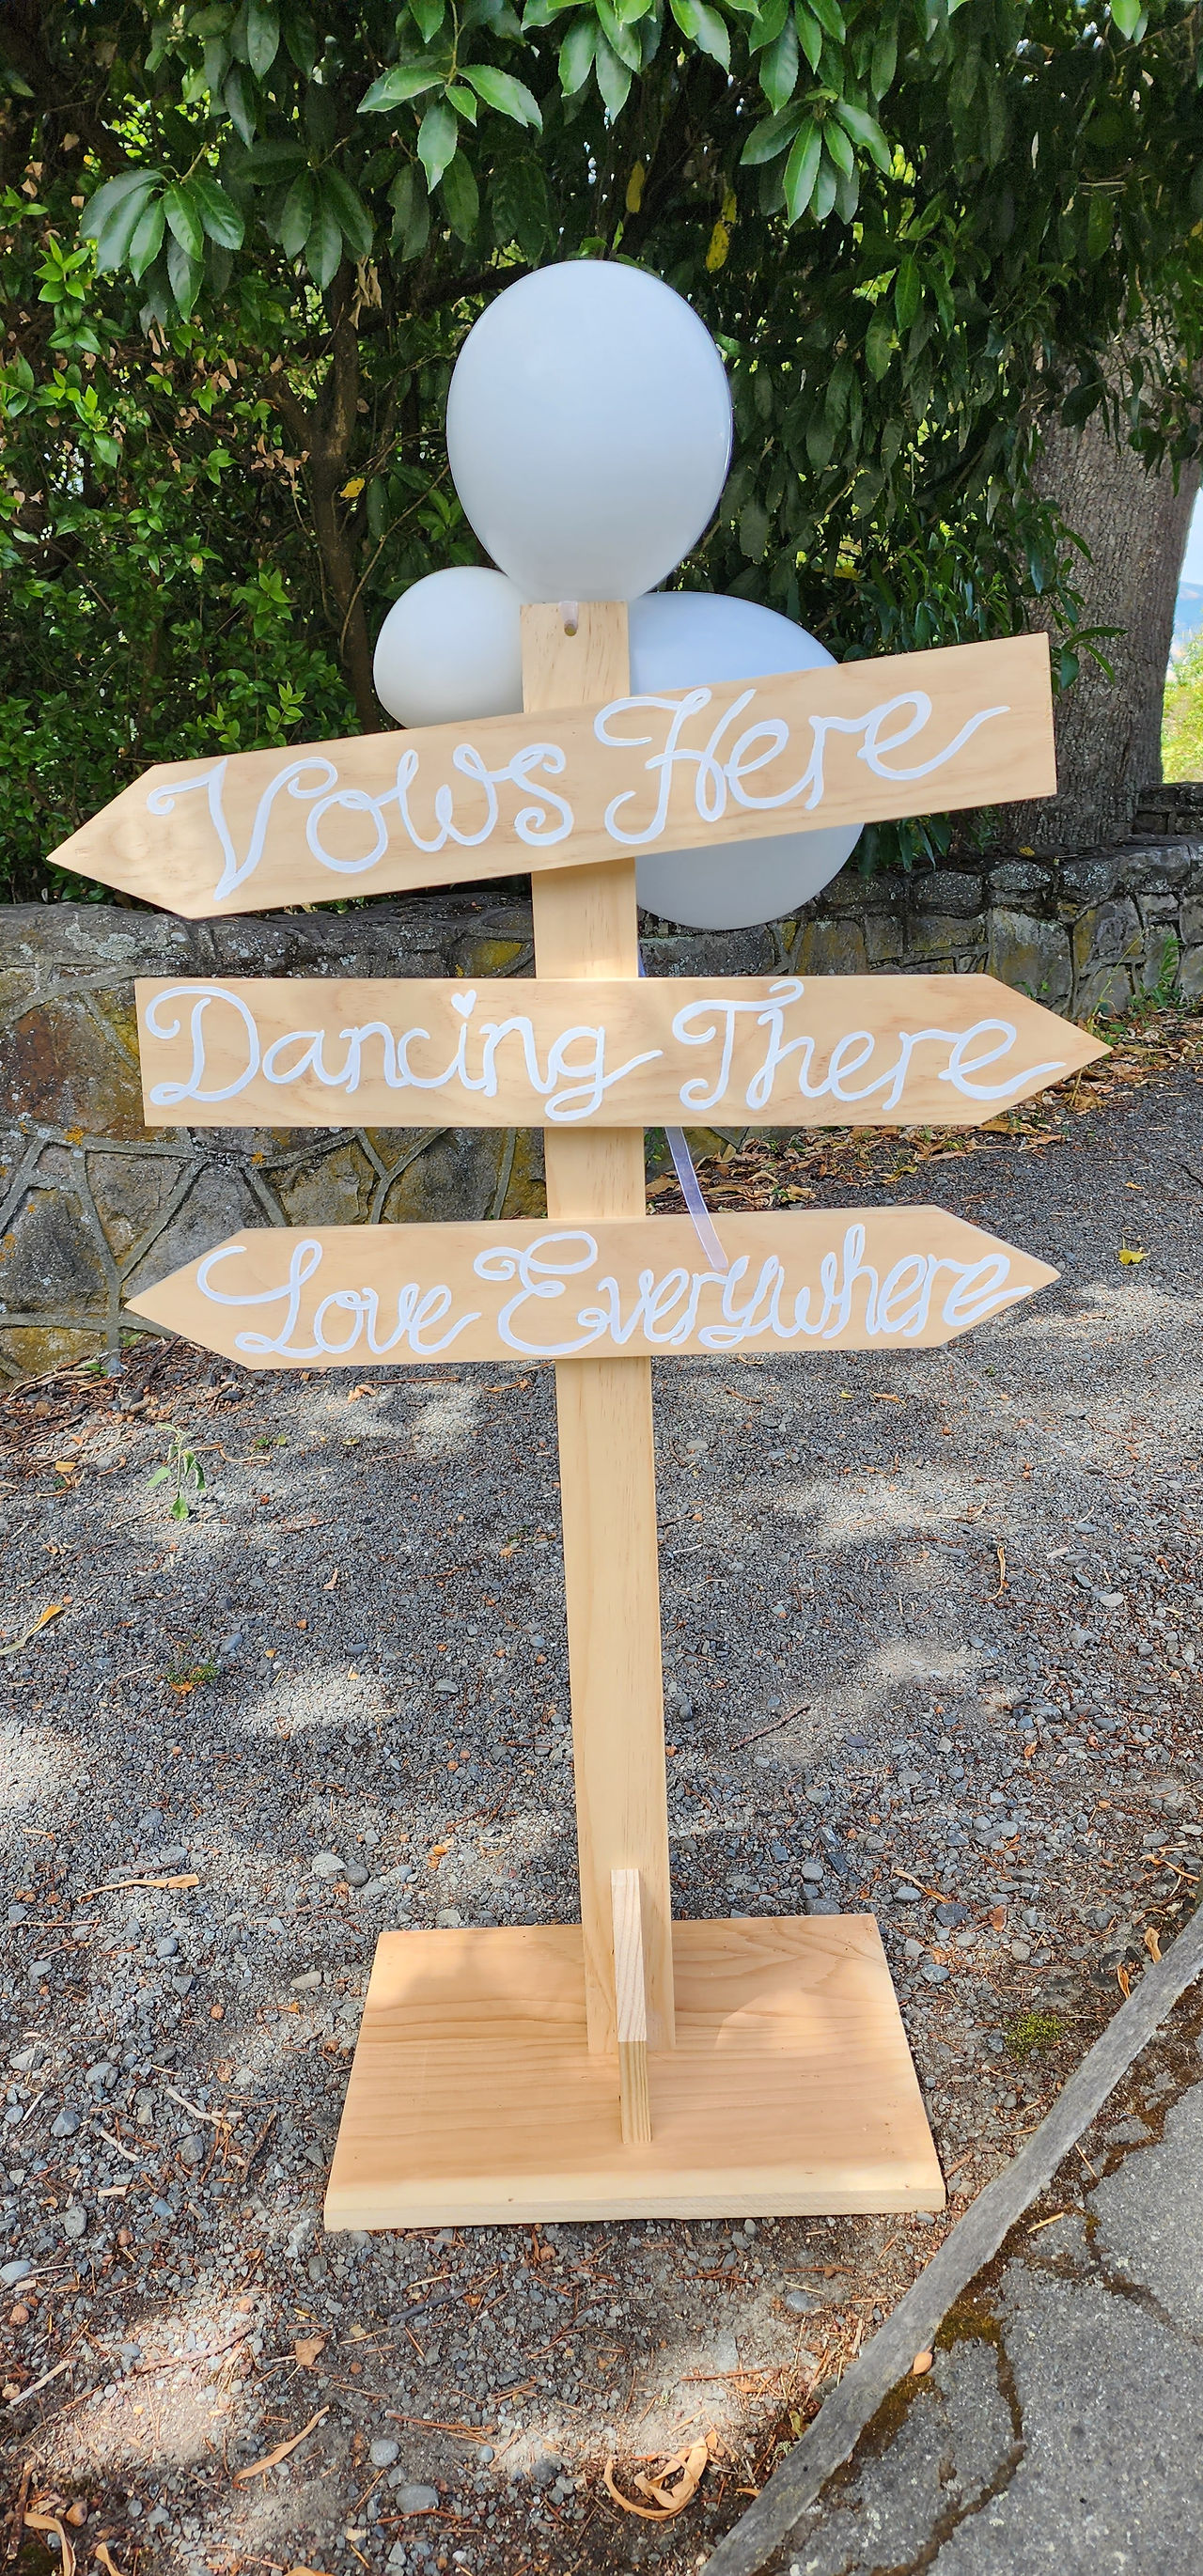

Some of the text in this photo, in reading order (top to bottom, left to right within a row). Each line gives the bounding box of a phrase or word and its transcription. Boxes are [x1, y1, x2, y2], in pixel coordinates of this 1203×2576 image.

[146, 687, 1010, 902] Vows Here
[144, 979, 1066, 1121] Dancing There
[195, 1222, 1033, 1358] Love Everywhere
